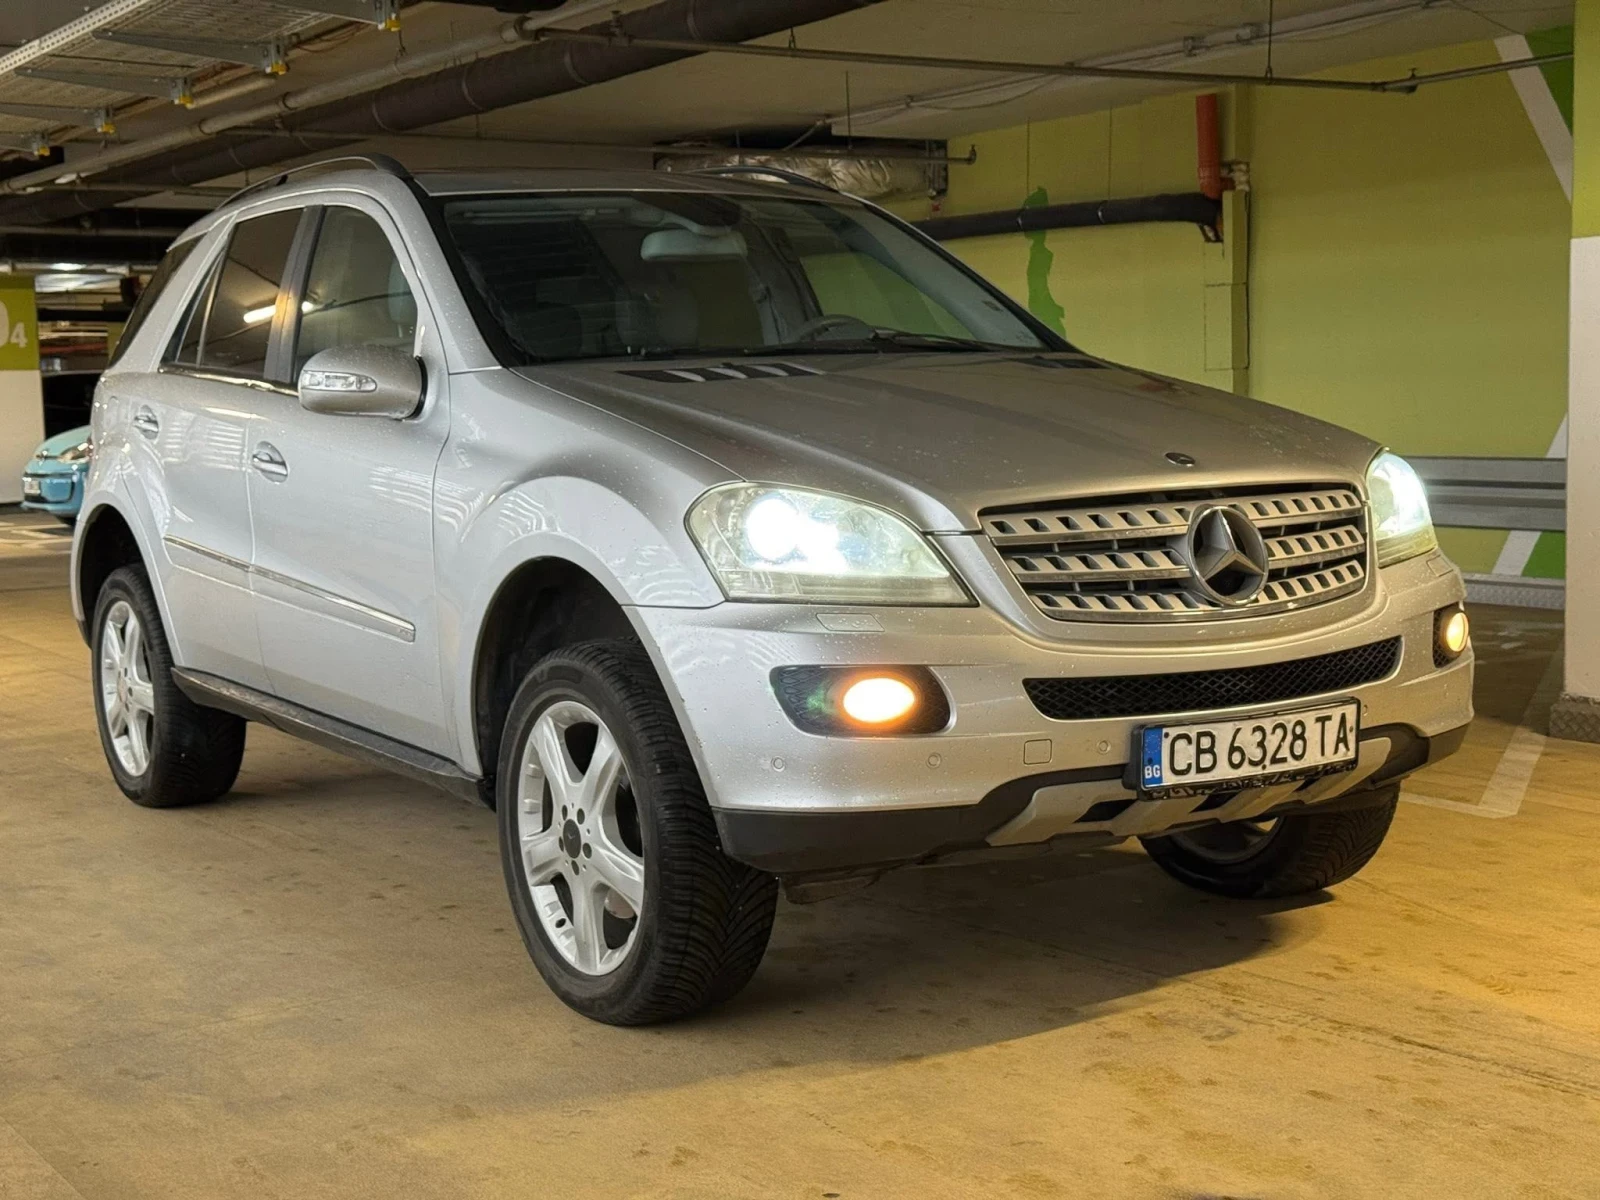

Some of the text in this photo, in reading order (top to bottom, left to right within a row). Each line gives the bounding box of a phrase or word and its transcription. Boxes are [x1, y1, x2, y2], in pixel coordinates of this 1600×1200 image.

[1169, 712, 1351, 776] CB 6328 TA
[1144, 764, 1161, 779] BG
